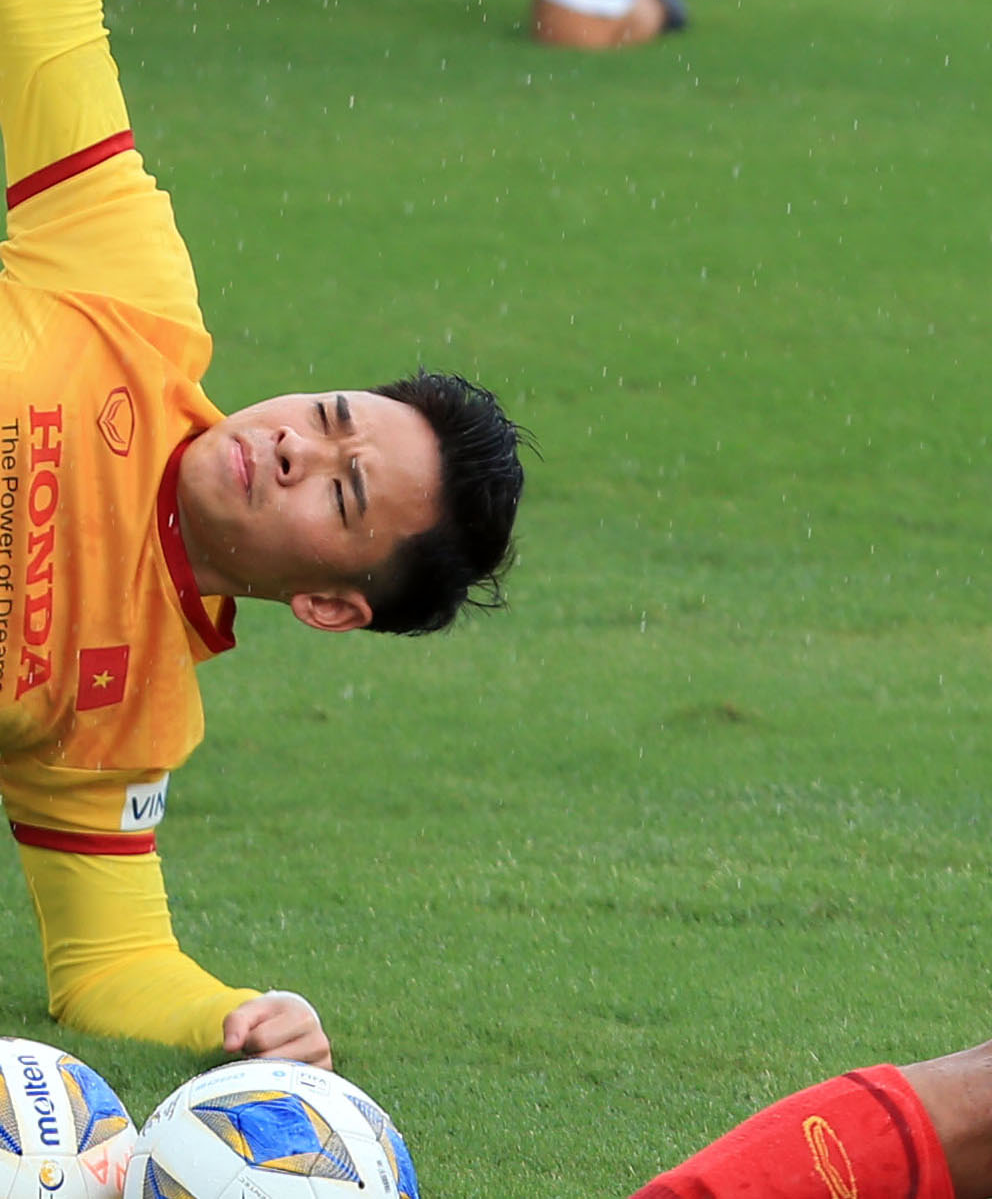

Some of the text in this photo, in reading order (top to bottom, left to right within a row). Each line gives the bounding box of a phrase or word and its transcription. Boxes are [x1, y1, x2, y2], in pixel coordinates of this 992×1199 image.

[1, 418, 19, 469] The
[15, 403, 63, 701] HONDA
[17, 1055, 60, 1146] molten
